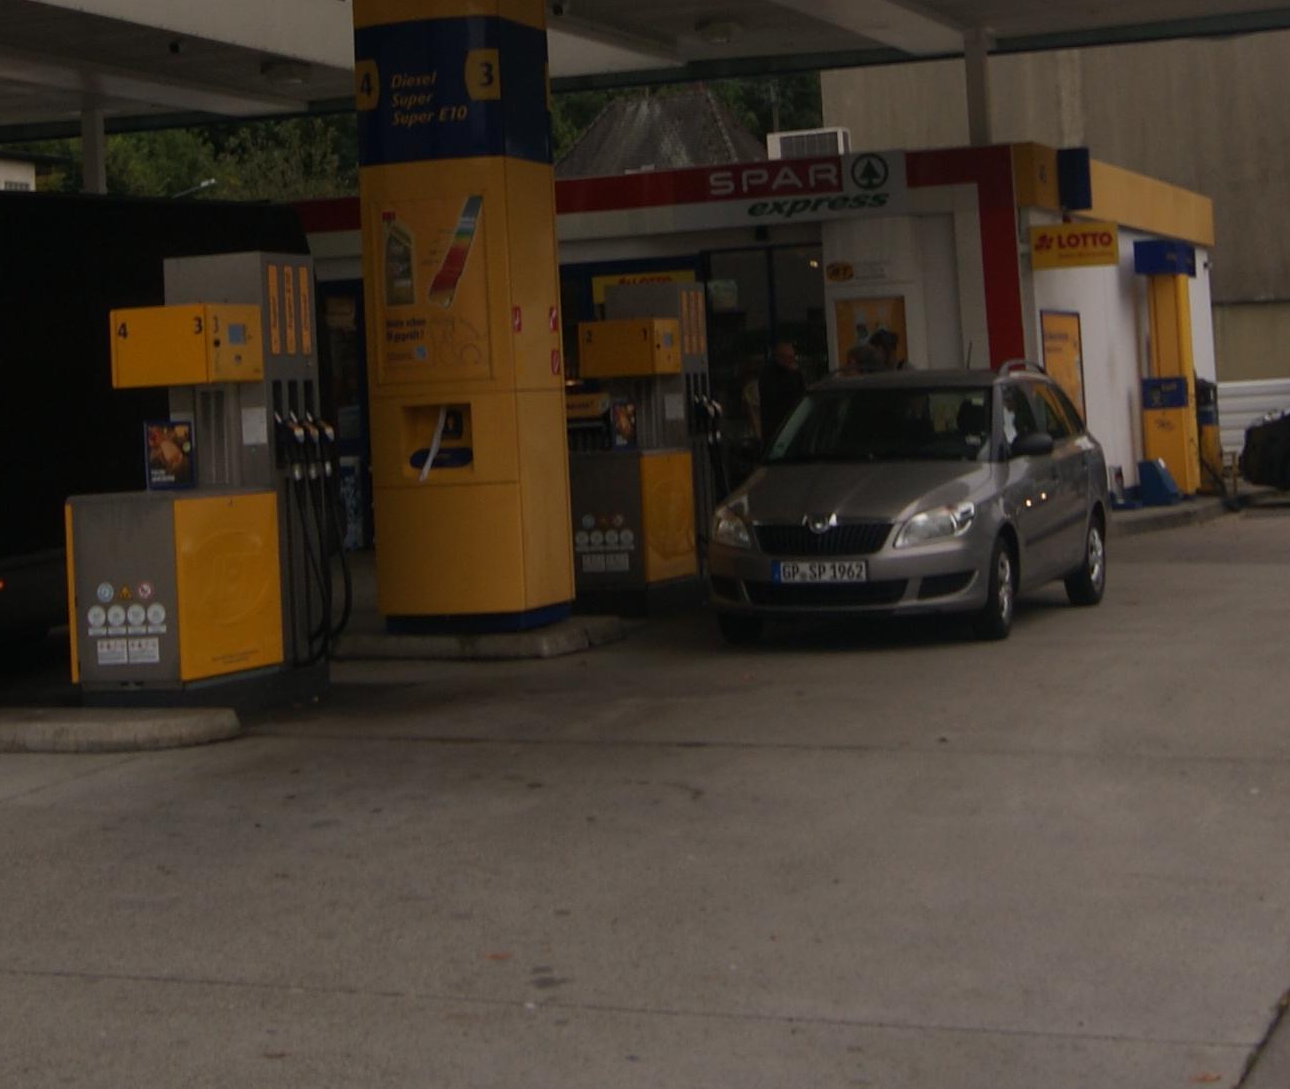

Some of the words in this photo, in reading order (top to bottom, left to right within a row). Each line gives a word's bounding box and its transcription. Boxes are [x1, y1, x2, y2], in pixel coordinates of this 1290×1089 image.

[359, 71, 373, 97] 4
[391, 70, 437, 89] Diesel
[479, 60, 494, 88] 3
[392, 93, 433, 109] Super
[393, 112, 435, 128] Super
[438, 105, 468, 122] E10
[709, 164, 838, 196] SPAR
[747, 192, 889, 218] express
[1057, 232, 1114, 249] LOTTO
[117, 322, 128, 339] 4
[193, 315, 203, 335] 3
[830, 563, 863, 580] 1962
